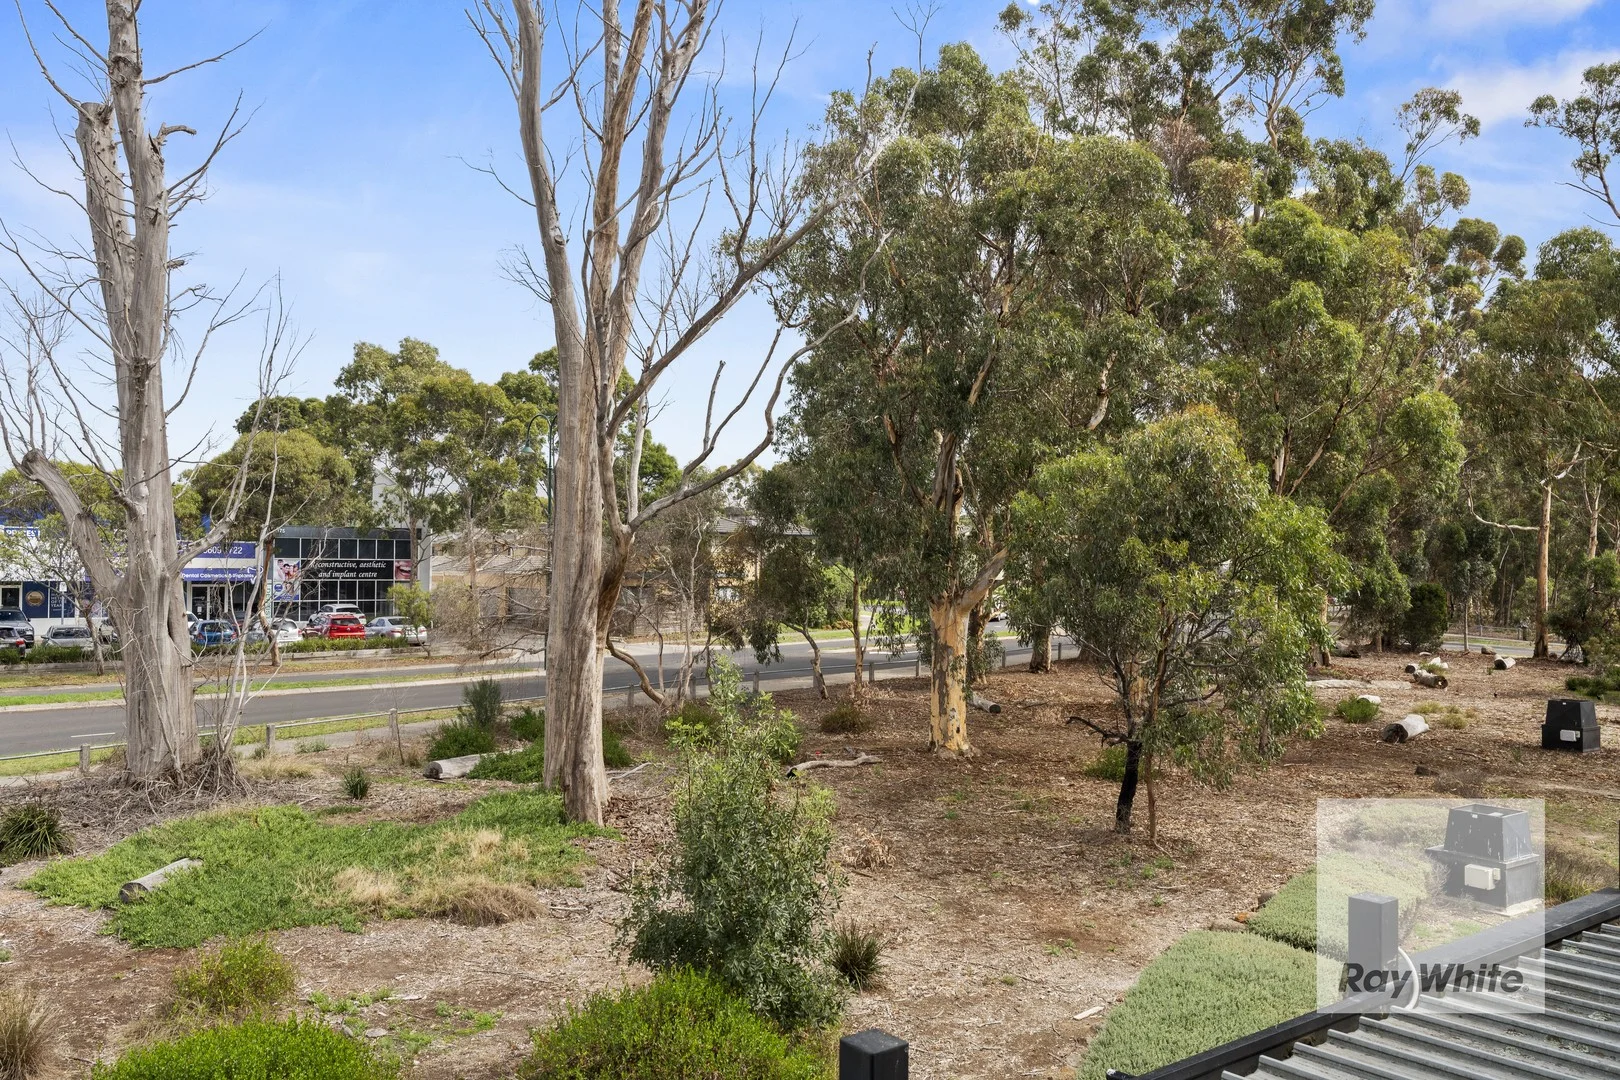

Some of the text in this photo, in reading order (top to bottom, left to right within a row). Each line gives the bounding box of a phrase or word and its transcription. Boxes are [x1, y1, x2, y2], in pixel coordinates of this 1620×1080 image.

[359, 560, 386, 568] aesthetic
[318, 569, 332, 578] and
[332, 569, 357, 580] implant
